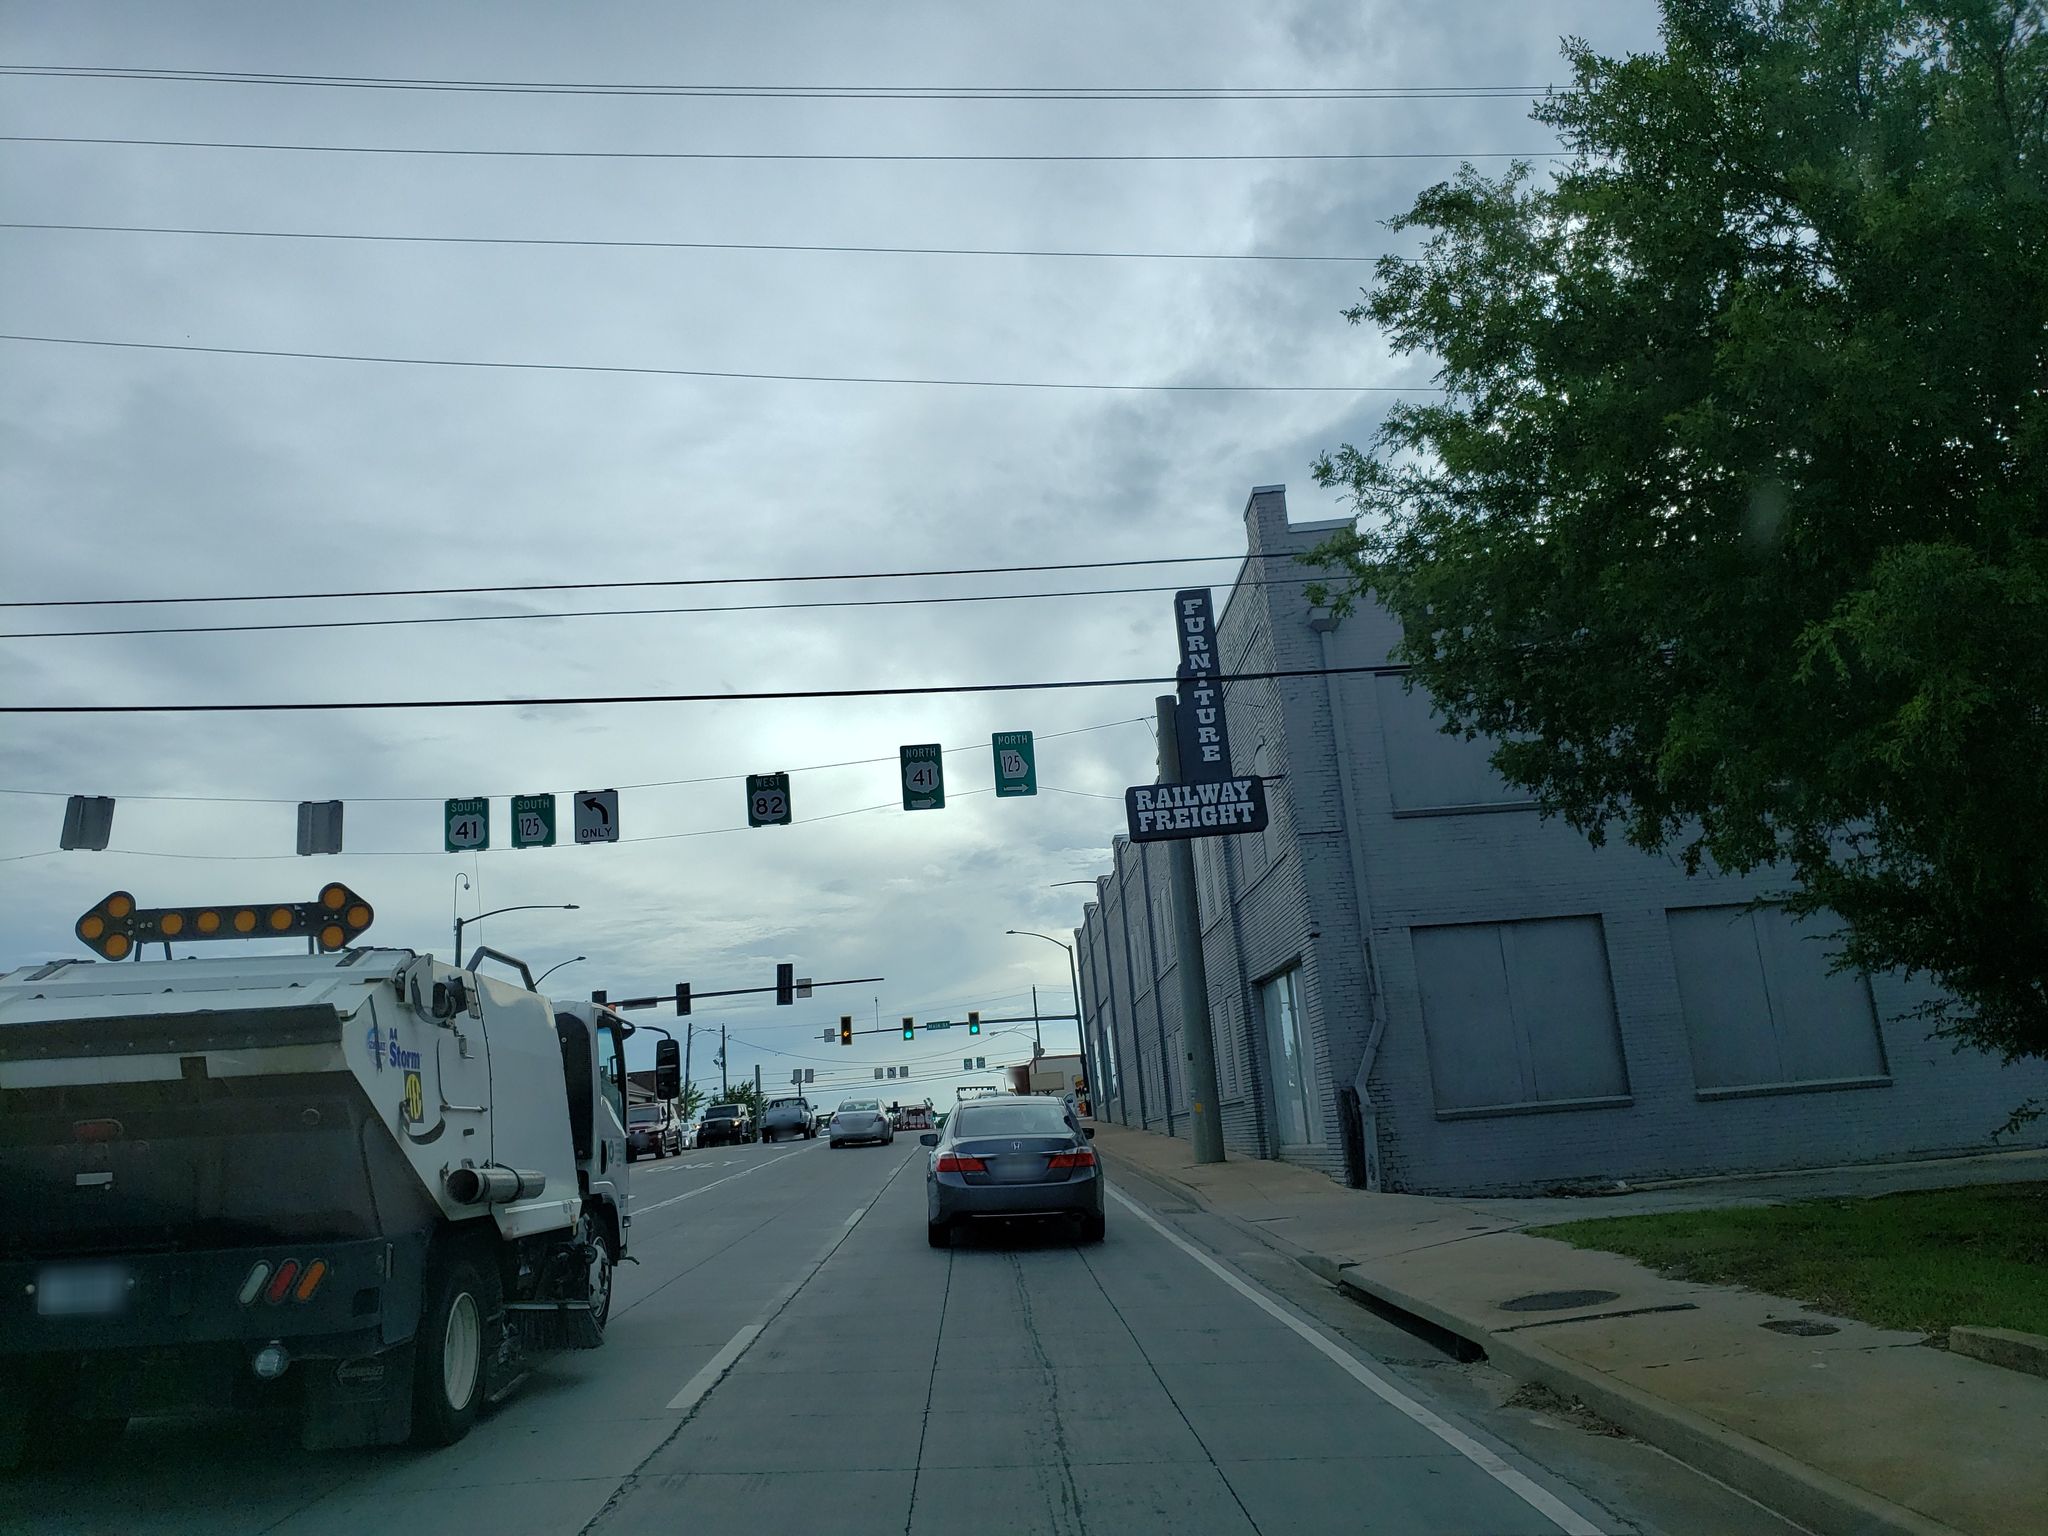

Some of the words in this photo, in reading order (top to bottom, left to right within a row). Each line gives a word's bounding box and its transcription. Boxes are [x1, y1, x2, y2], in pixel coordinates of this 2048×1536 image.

[1183, 599, 1221, 762] FURNITURE
[997, 734, 1028, 745] NORTH
[906, 747, 937, 758] NORTH
[1003, 755, 1021, 773] 125
[755, 776, 781, 788] WEST
[912, 768, 933, 786] 41
[517, 799, 550, 810] SOUTH
[1135, 780, 1252, 811] RAILWAY
[451, 801, 483, 812] SOUTH
[756, 796, 784, 815] 82
[1138, 801, 1255, 833] FREIGHT
[455, 821, 478, 839] 41
[520, 817, 540, 836] 125
[581, 826, 613, 838] ONLY
[389, 1041, 421, 1070] Storm
[646, 1159, 747, 1173] ONLY
